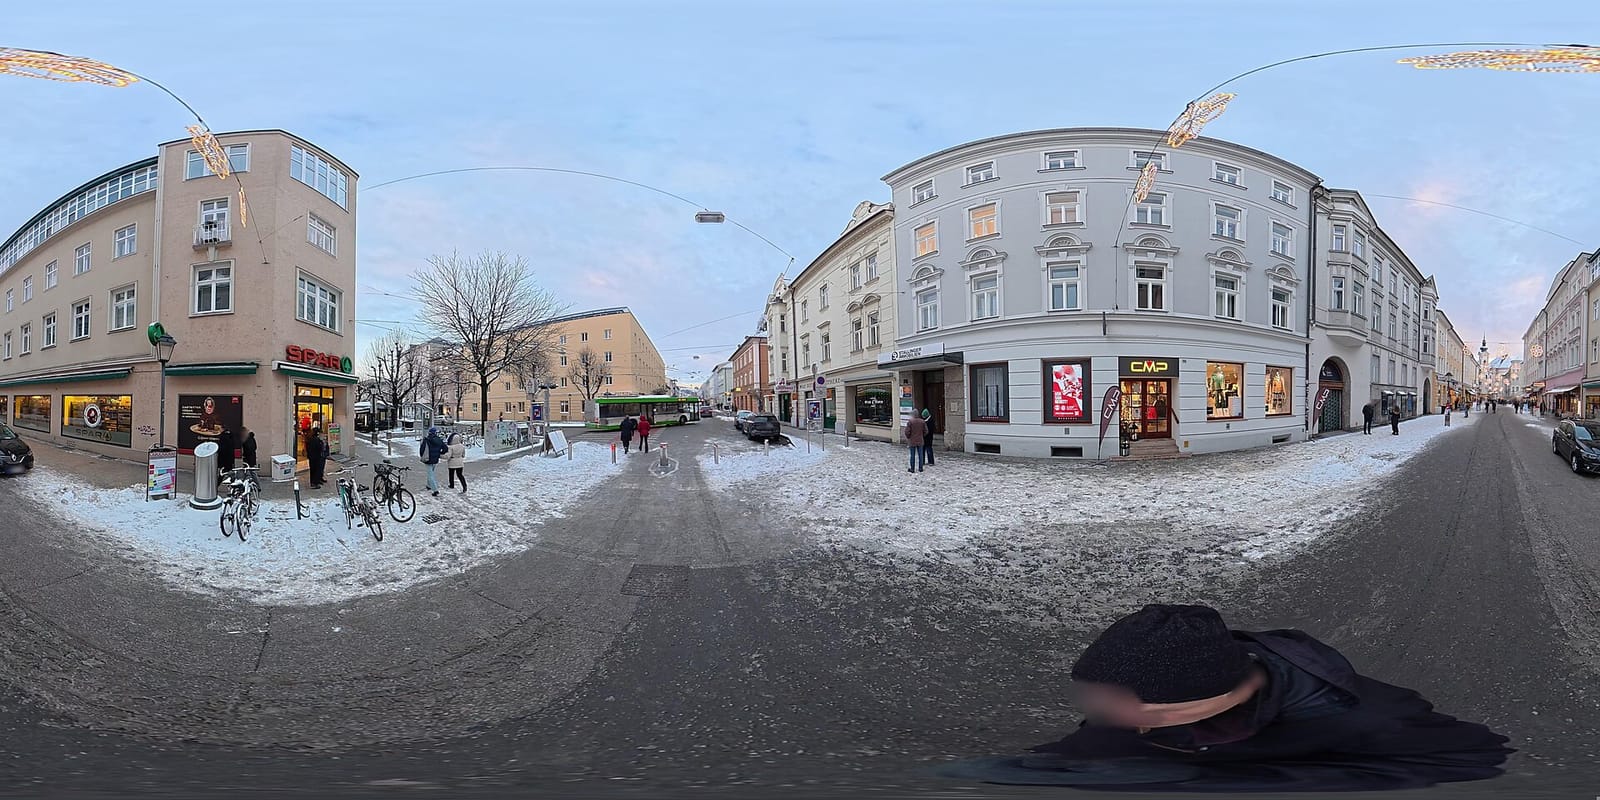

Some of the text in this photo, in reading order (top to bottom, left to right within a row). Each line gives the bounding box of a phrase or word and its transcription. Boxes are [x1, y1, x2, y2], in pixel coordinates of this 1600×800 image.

[286, 344, 341, 370] SPAR
[1130, 360, 1168, 373] CMP
[1104, 389, 1120, 419] CMP
[75, 428, 103, 441] SPAR
